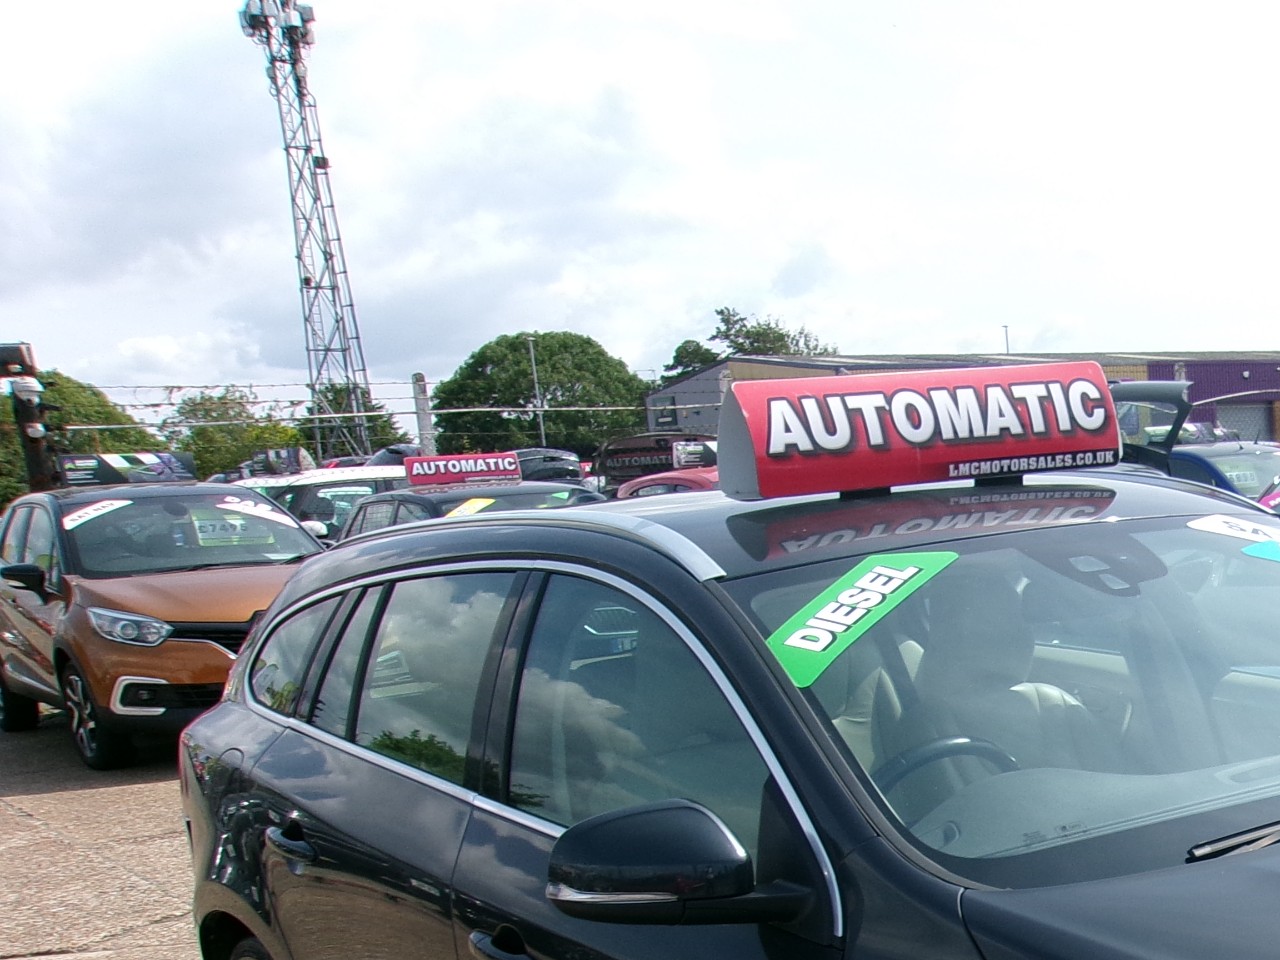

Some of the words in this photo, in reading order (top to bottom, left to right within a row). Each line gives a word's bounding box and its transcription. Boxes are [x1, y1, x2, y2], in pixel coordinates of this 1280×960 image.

[768, 379, 1106, 455] AUTOMATIC
[411, 457, 517, 476] AUTOMATIC
[606, 455, 673, 467] AUTOMATI
[949, 450, 1115, 477] LMCMOTORSALES.CO.UK
[784, 565, 921, 653] DIESEL
